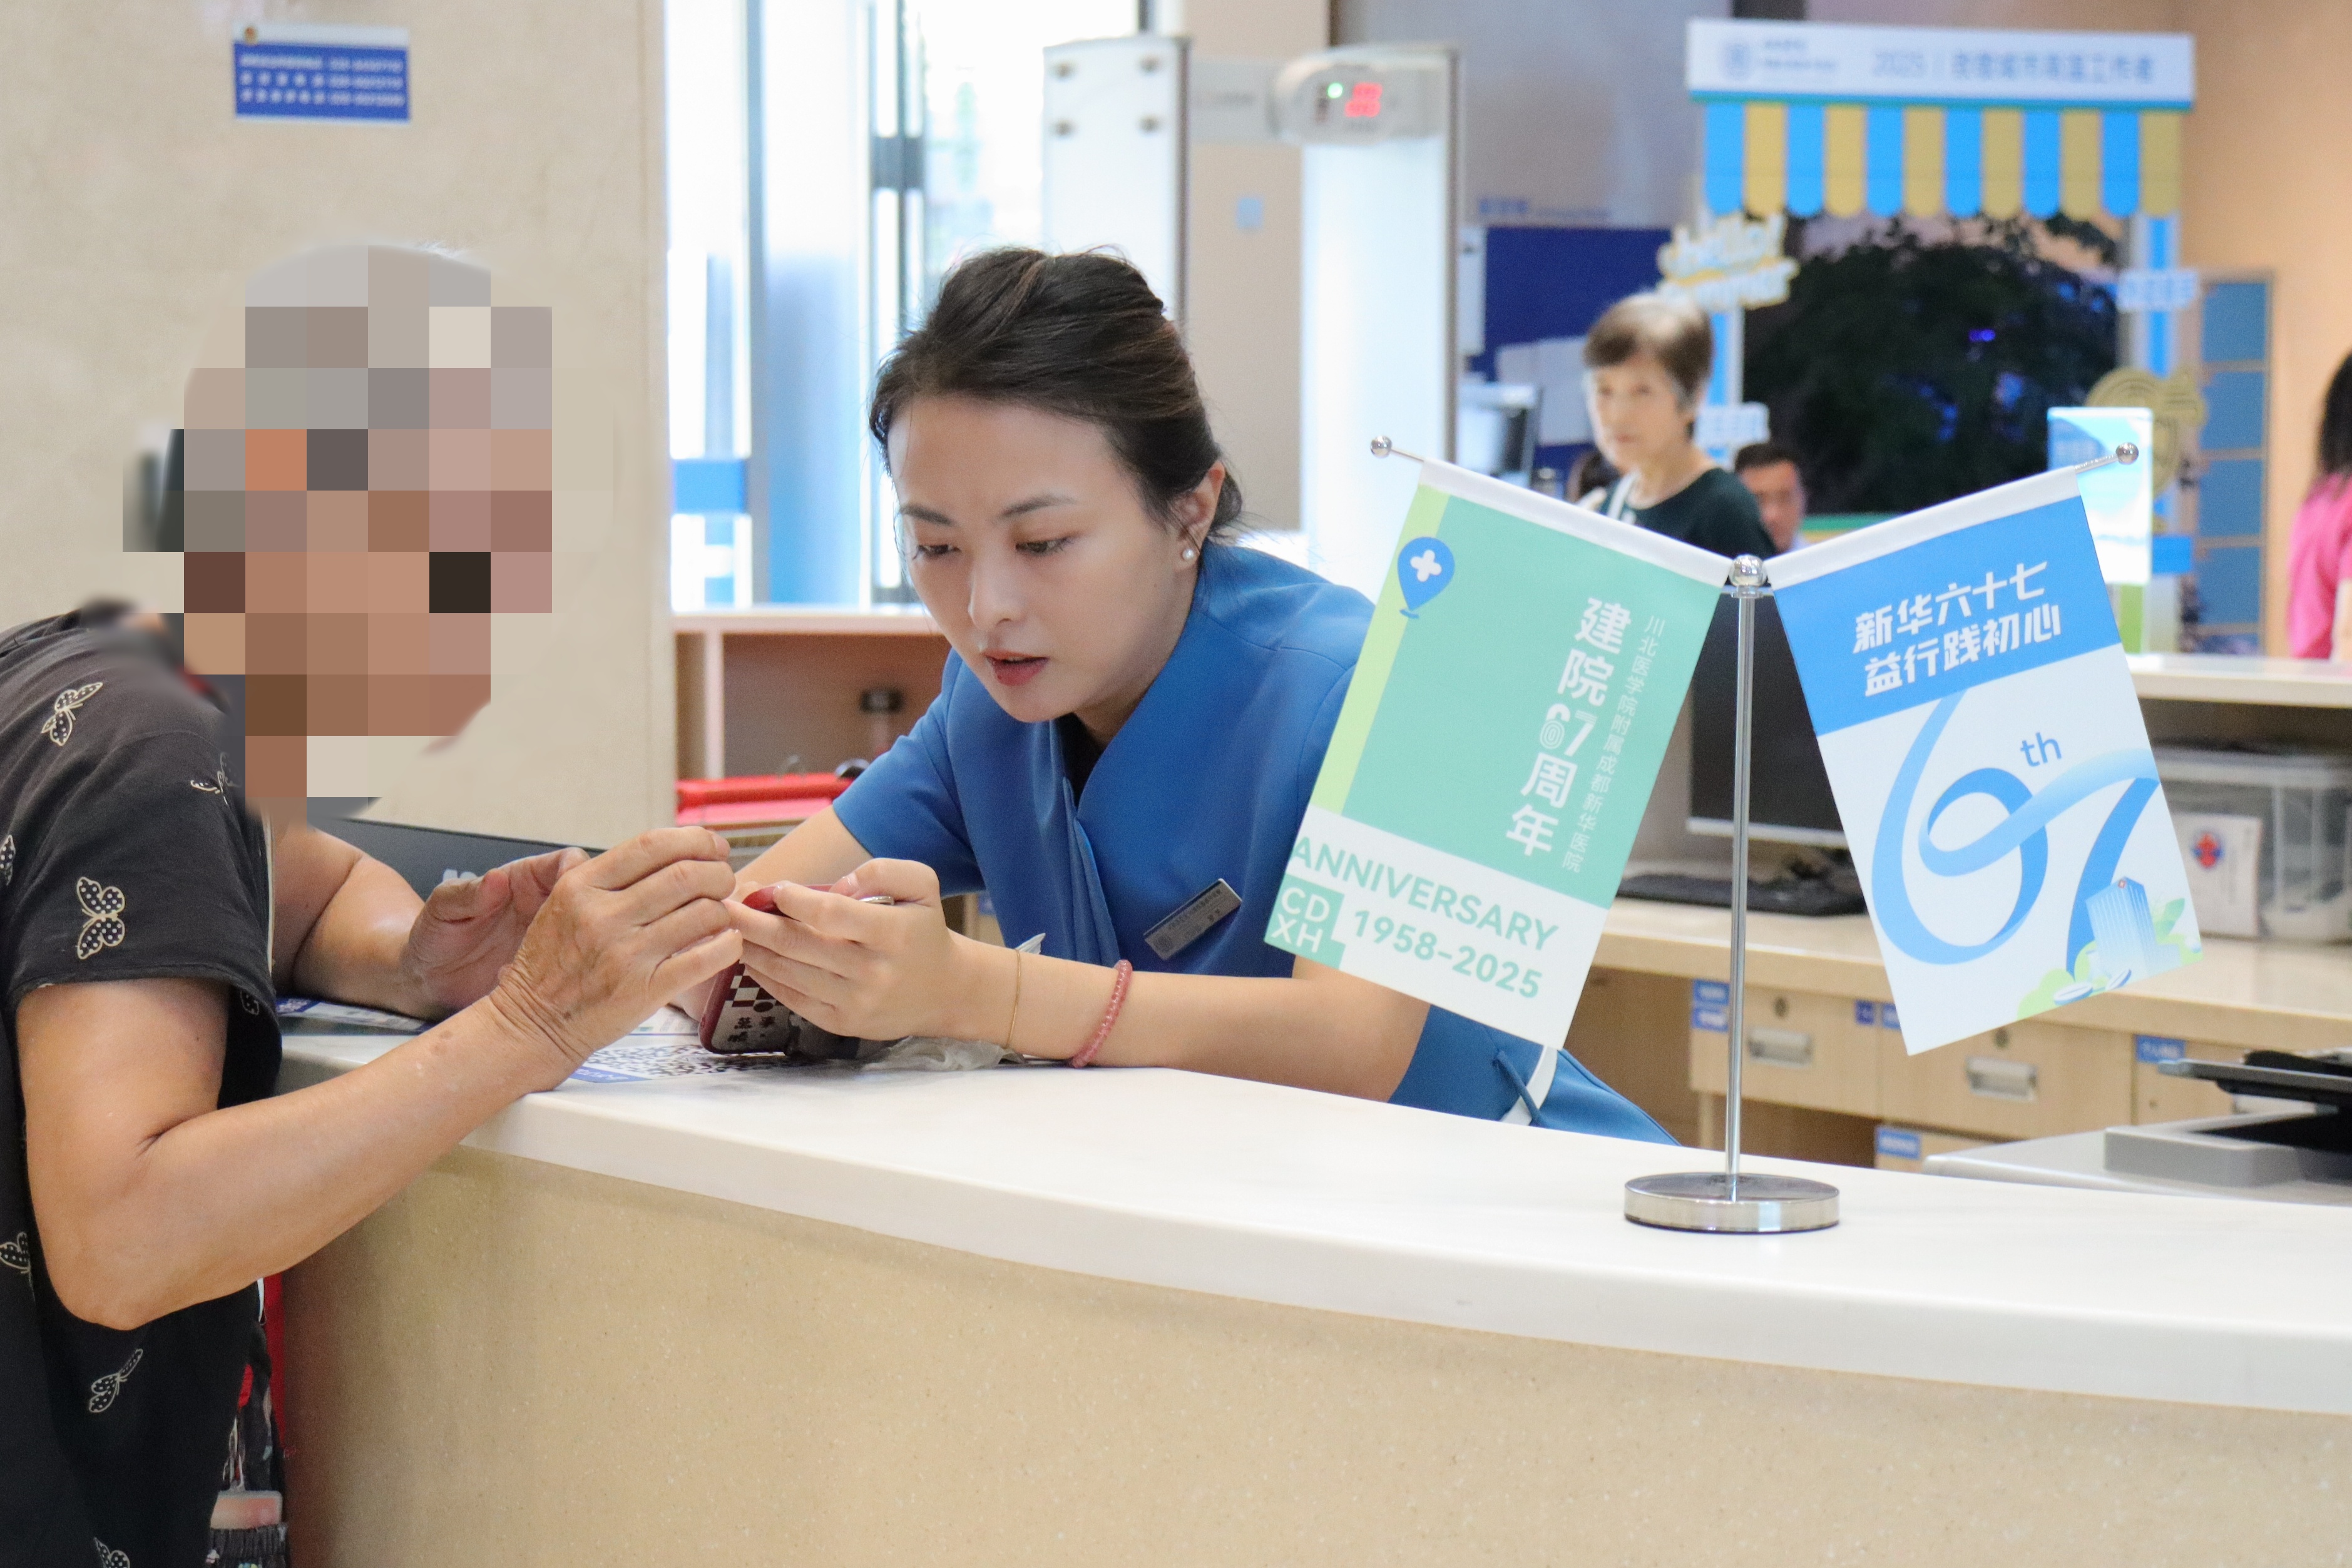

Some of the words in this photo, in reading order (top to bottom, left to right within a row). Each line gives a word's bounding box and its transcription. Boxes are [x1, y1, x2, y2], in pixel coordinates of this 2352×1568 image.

[1852, 560, 2048, 654] 新华六十七
[1864, 603, 2062, 697] 益行践初心
[1505, 596, 1632, 857] 建院67周年
[1562, 615, 1666, 873] 川北医学院附属成都新华医院
[2020, 733, 2062, 768] th
[1271, 914, 1324, 954] XH
[1281, 887, 1331, 924] CD
[1288, 835, 1560, 951] ANNIVERSARY
[1354, 910, 1543, 999] 1958-2025
